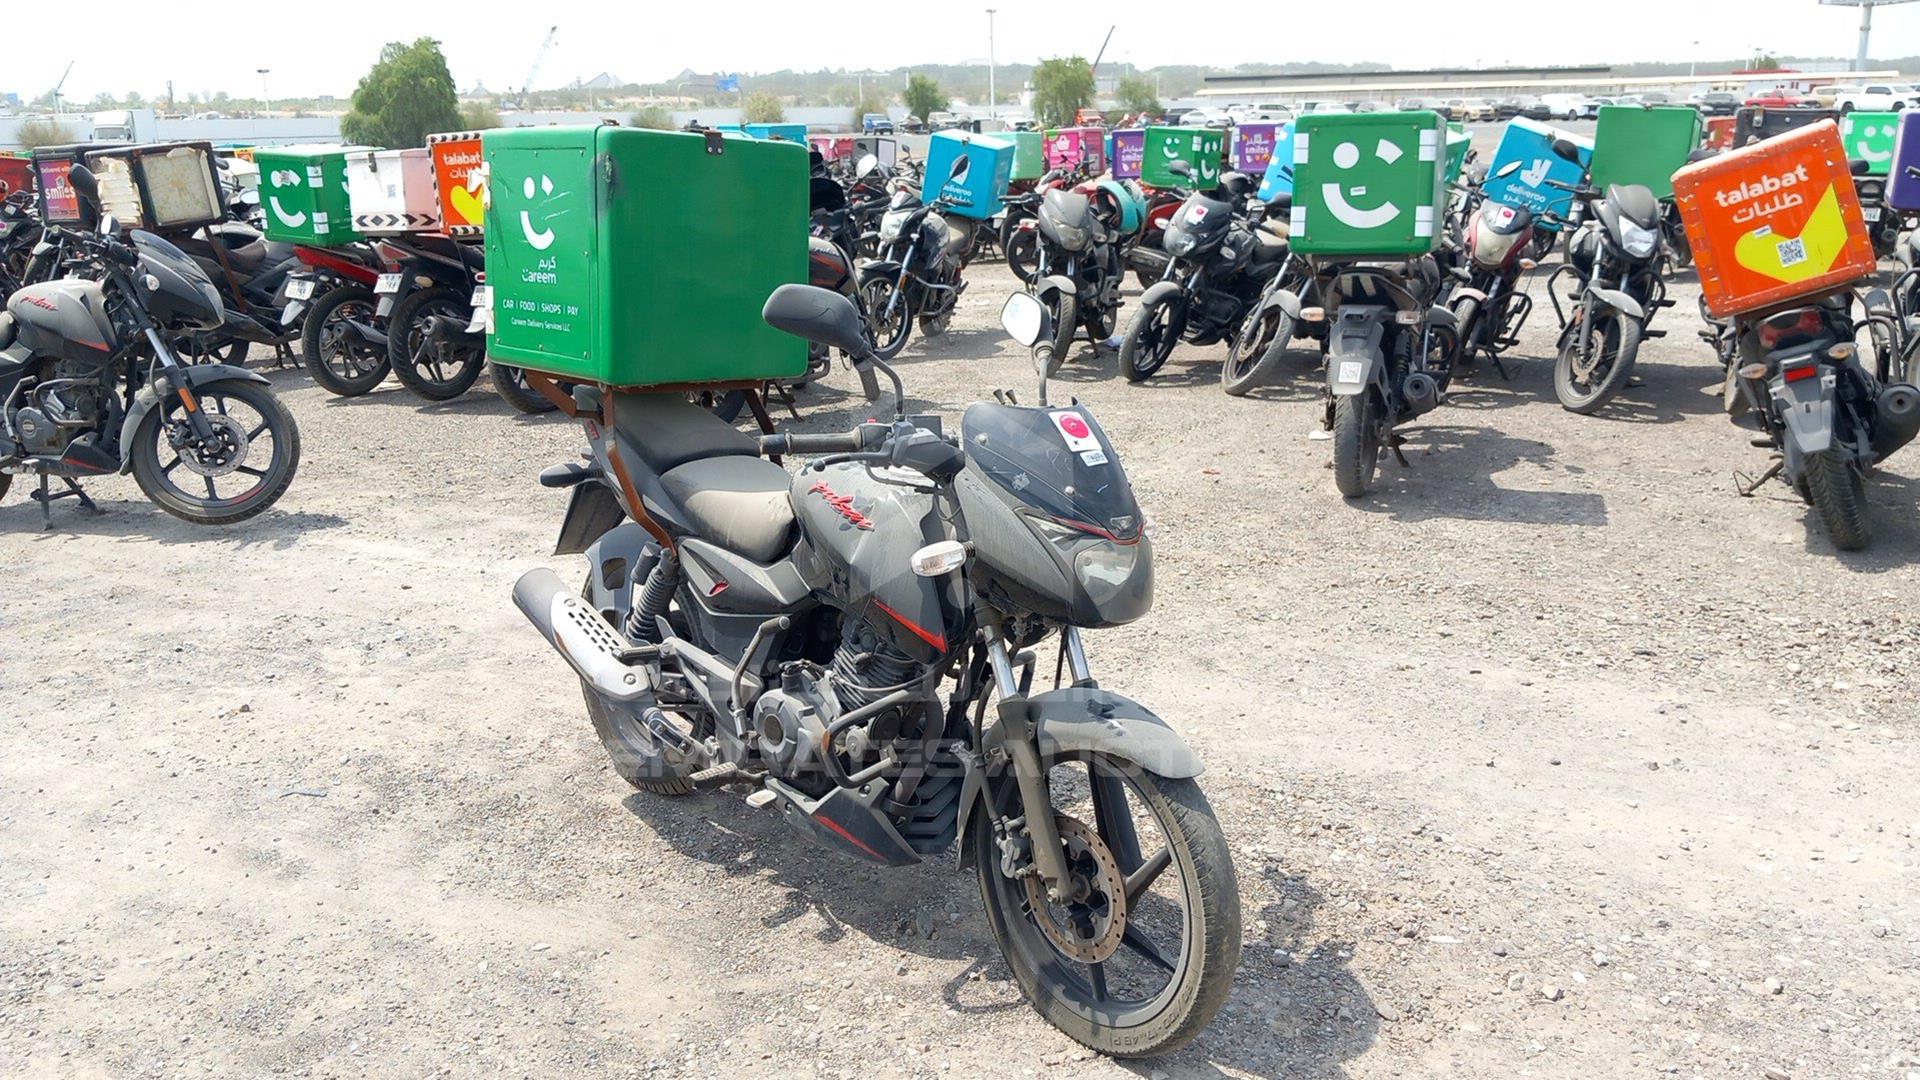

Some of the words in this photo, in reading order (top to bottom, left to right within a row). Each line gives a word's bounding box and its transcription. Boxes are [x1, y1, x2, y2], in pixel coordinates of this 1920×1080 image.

[443, 151, 481, 166] talabat
[1506, 183, 1546, 203] deliveroo
[1714, 163, 1809, 207] talabat
[1732, 192, 1804, 224] طلبات
[538, 256, 556, 271] كريم
[521, 268, 557, 285] Careem
[502, 299, 514, 309] CAR
[519, 300, 536, 312] FOOD
[541, 302, 561, 315] SHOPS
[567, 305, 579, 316] PAY
